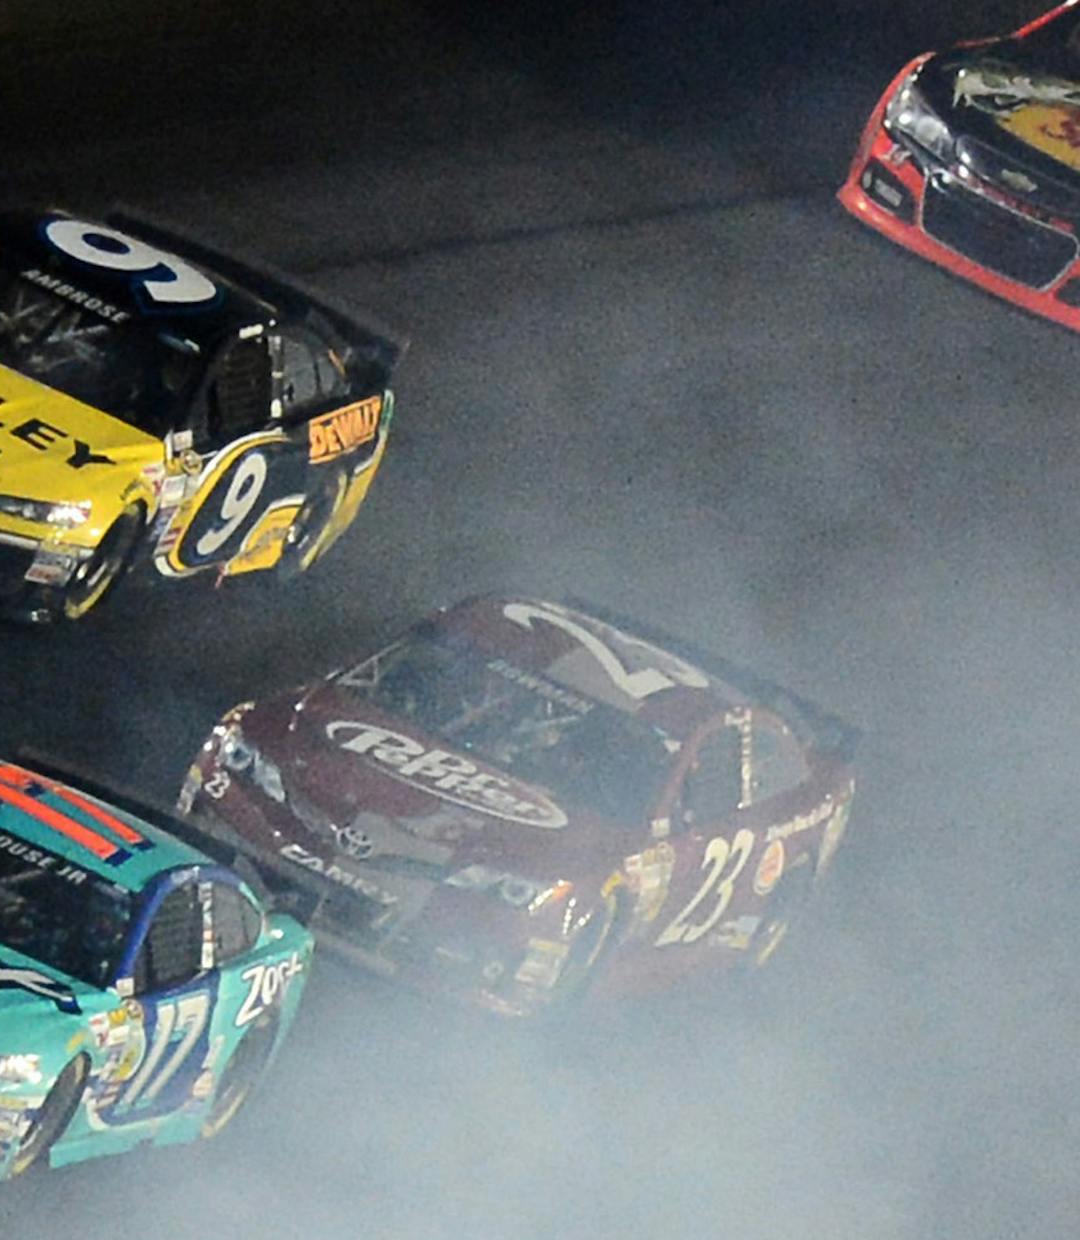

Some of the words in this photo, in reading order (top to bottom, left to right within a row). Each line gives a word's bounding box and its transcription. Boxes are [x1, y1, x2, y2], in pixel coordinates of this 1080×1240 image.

[21, 268, 130, 324] AMBROSE
[46, 219, 217, 303] 9
[197, 453, 267, 555] 9
[204, 769, 231, 799] 23
[56, 866, 88, 885] JR
[656, 829, 754, 947] 23
[125, 992, 210, 1105] 17
